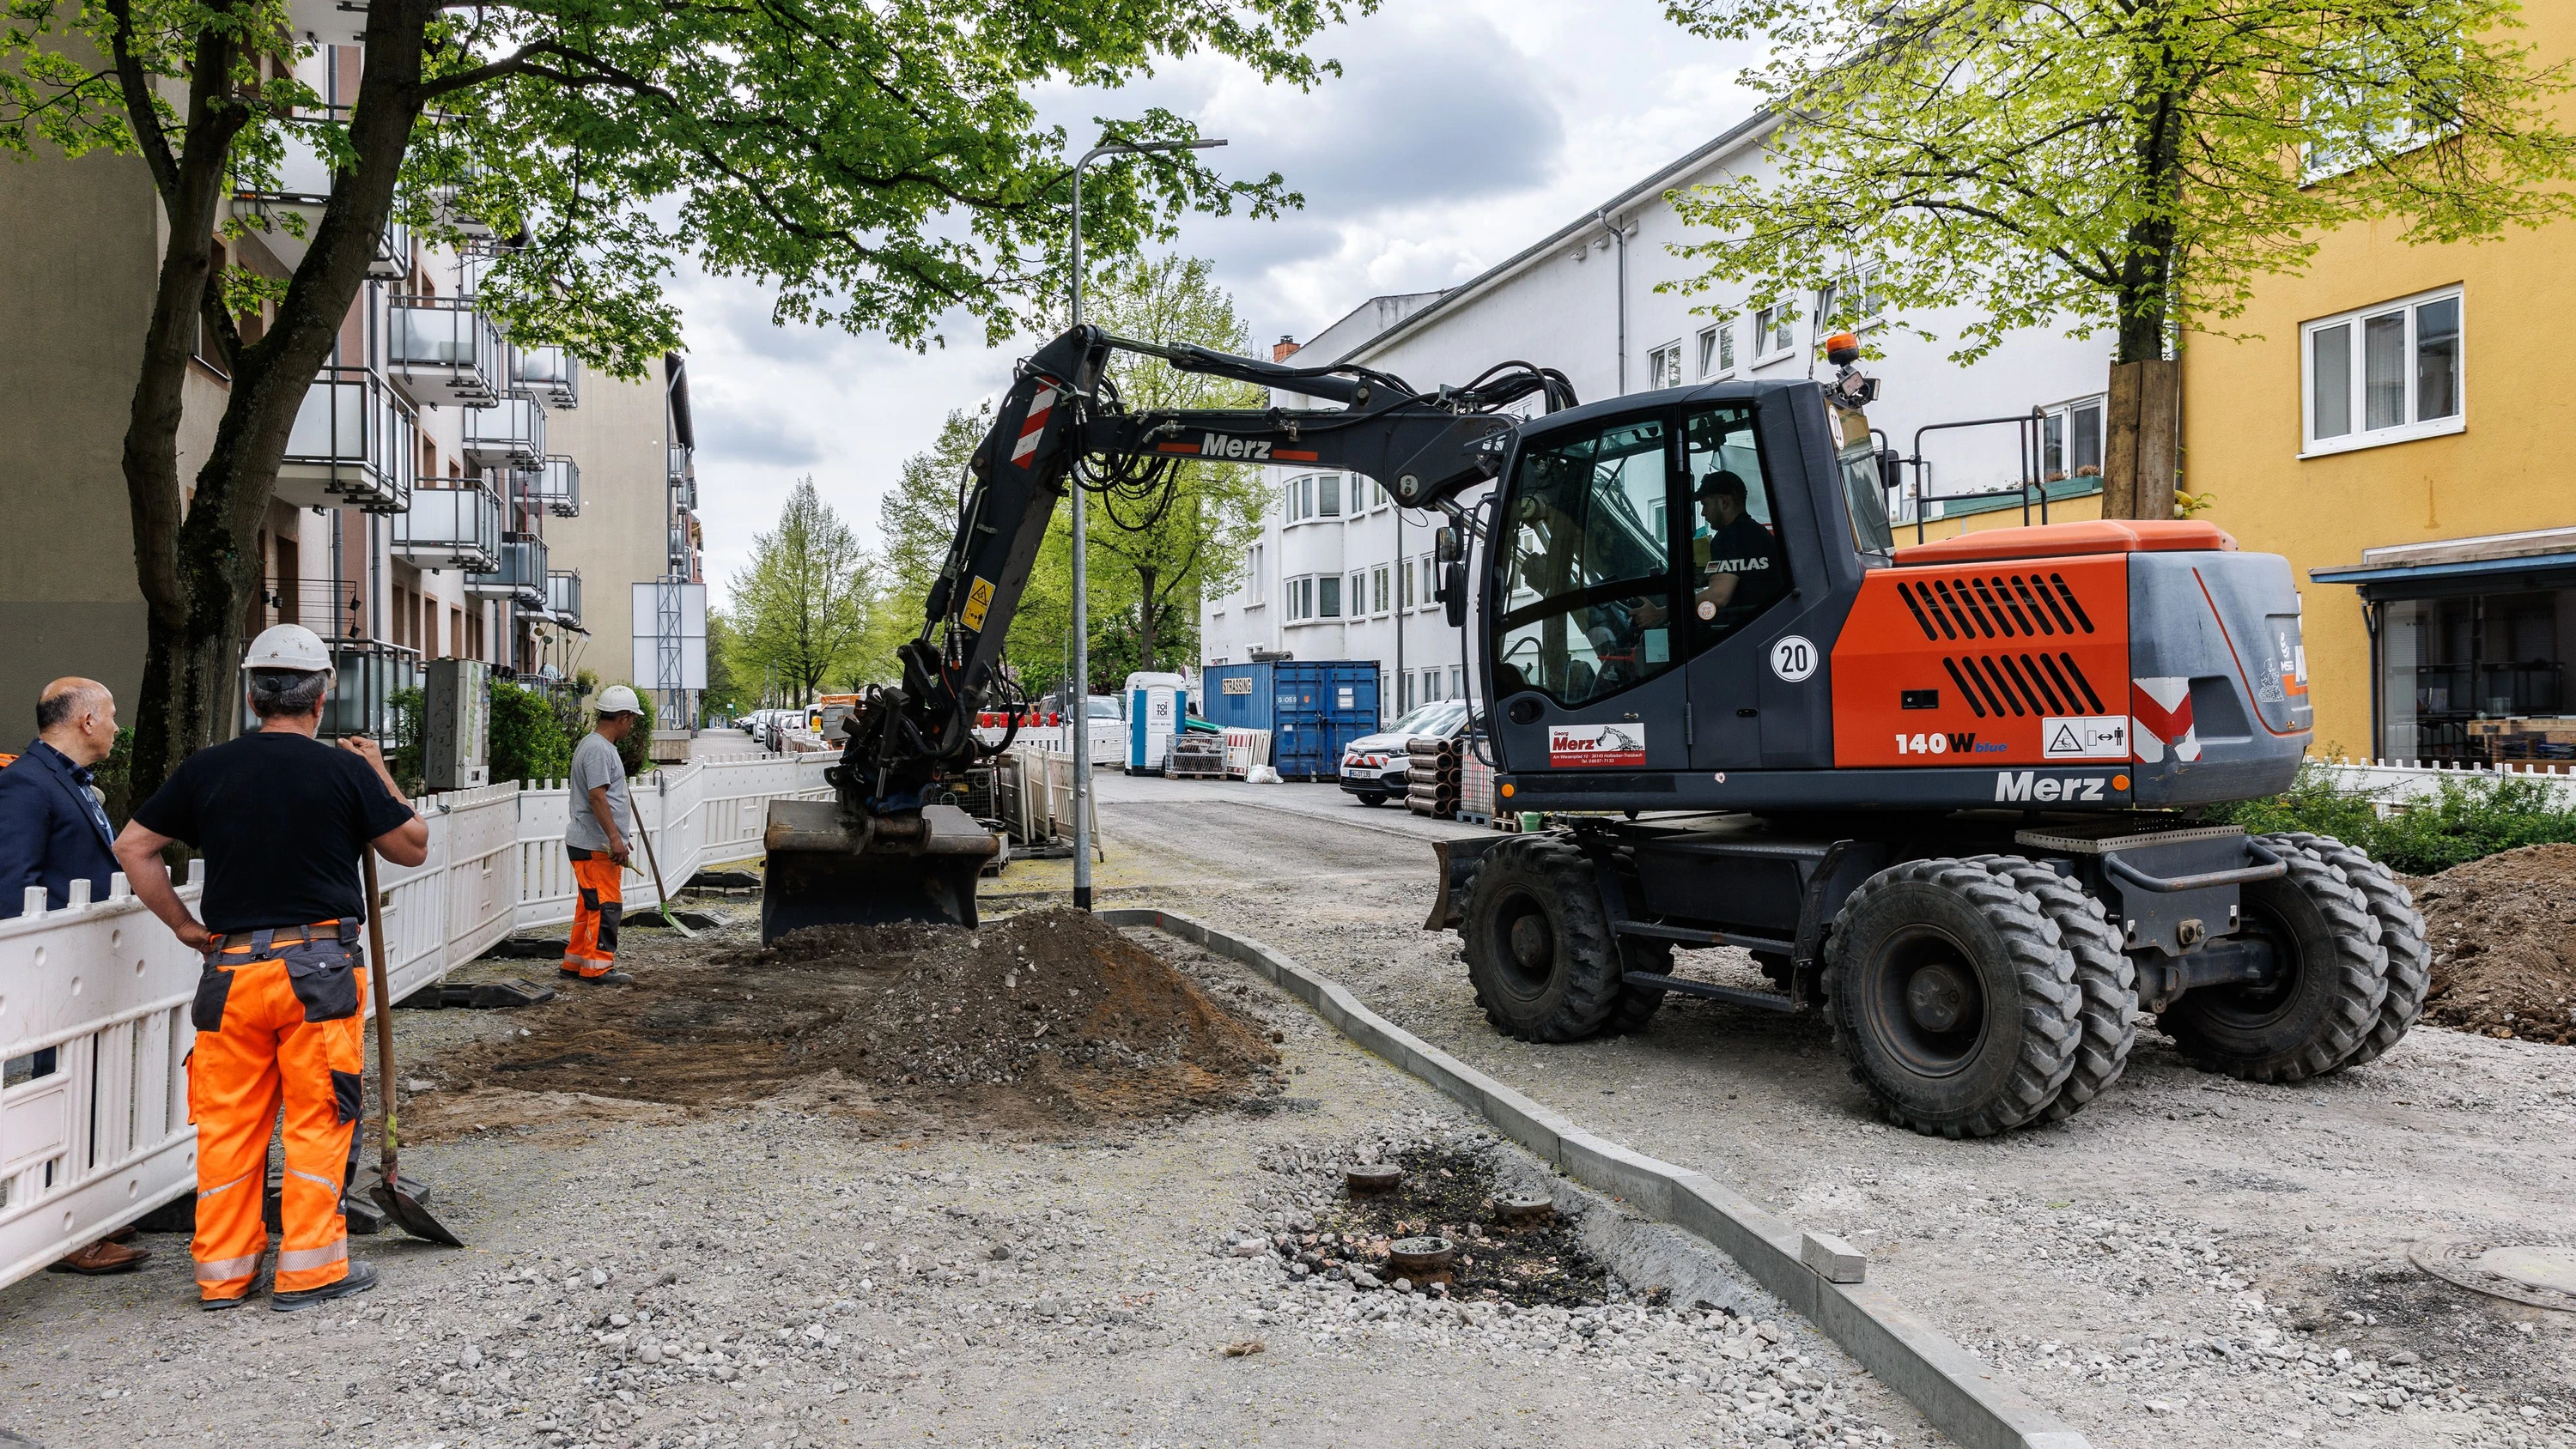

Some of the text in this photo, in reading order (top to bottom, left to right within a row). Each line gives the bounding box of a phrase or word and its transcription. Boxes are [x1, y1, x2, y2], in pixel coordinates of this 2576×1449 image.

[1831, 414, 1842, 441] 20
[1201, 433, 1272, 459] Merz
[1718, 556, 1769, 573] ATLAS
[1781, 645, 1807, 673] 20
[1223, 679, 1251, 693] STRASSING
[1552, 737, 1595, 750] Merz
[1976, 743, 2008, 753] blue
[1995, 772, 2105, 802] Merz
